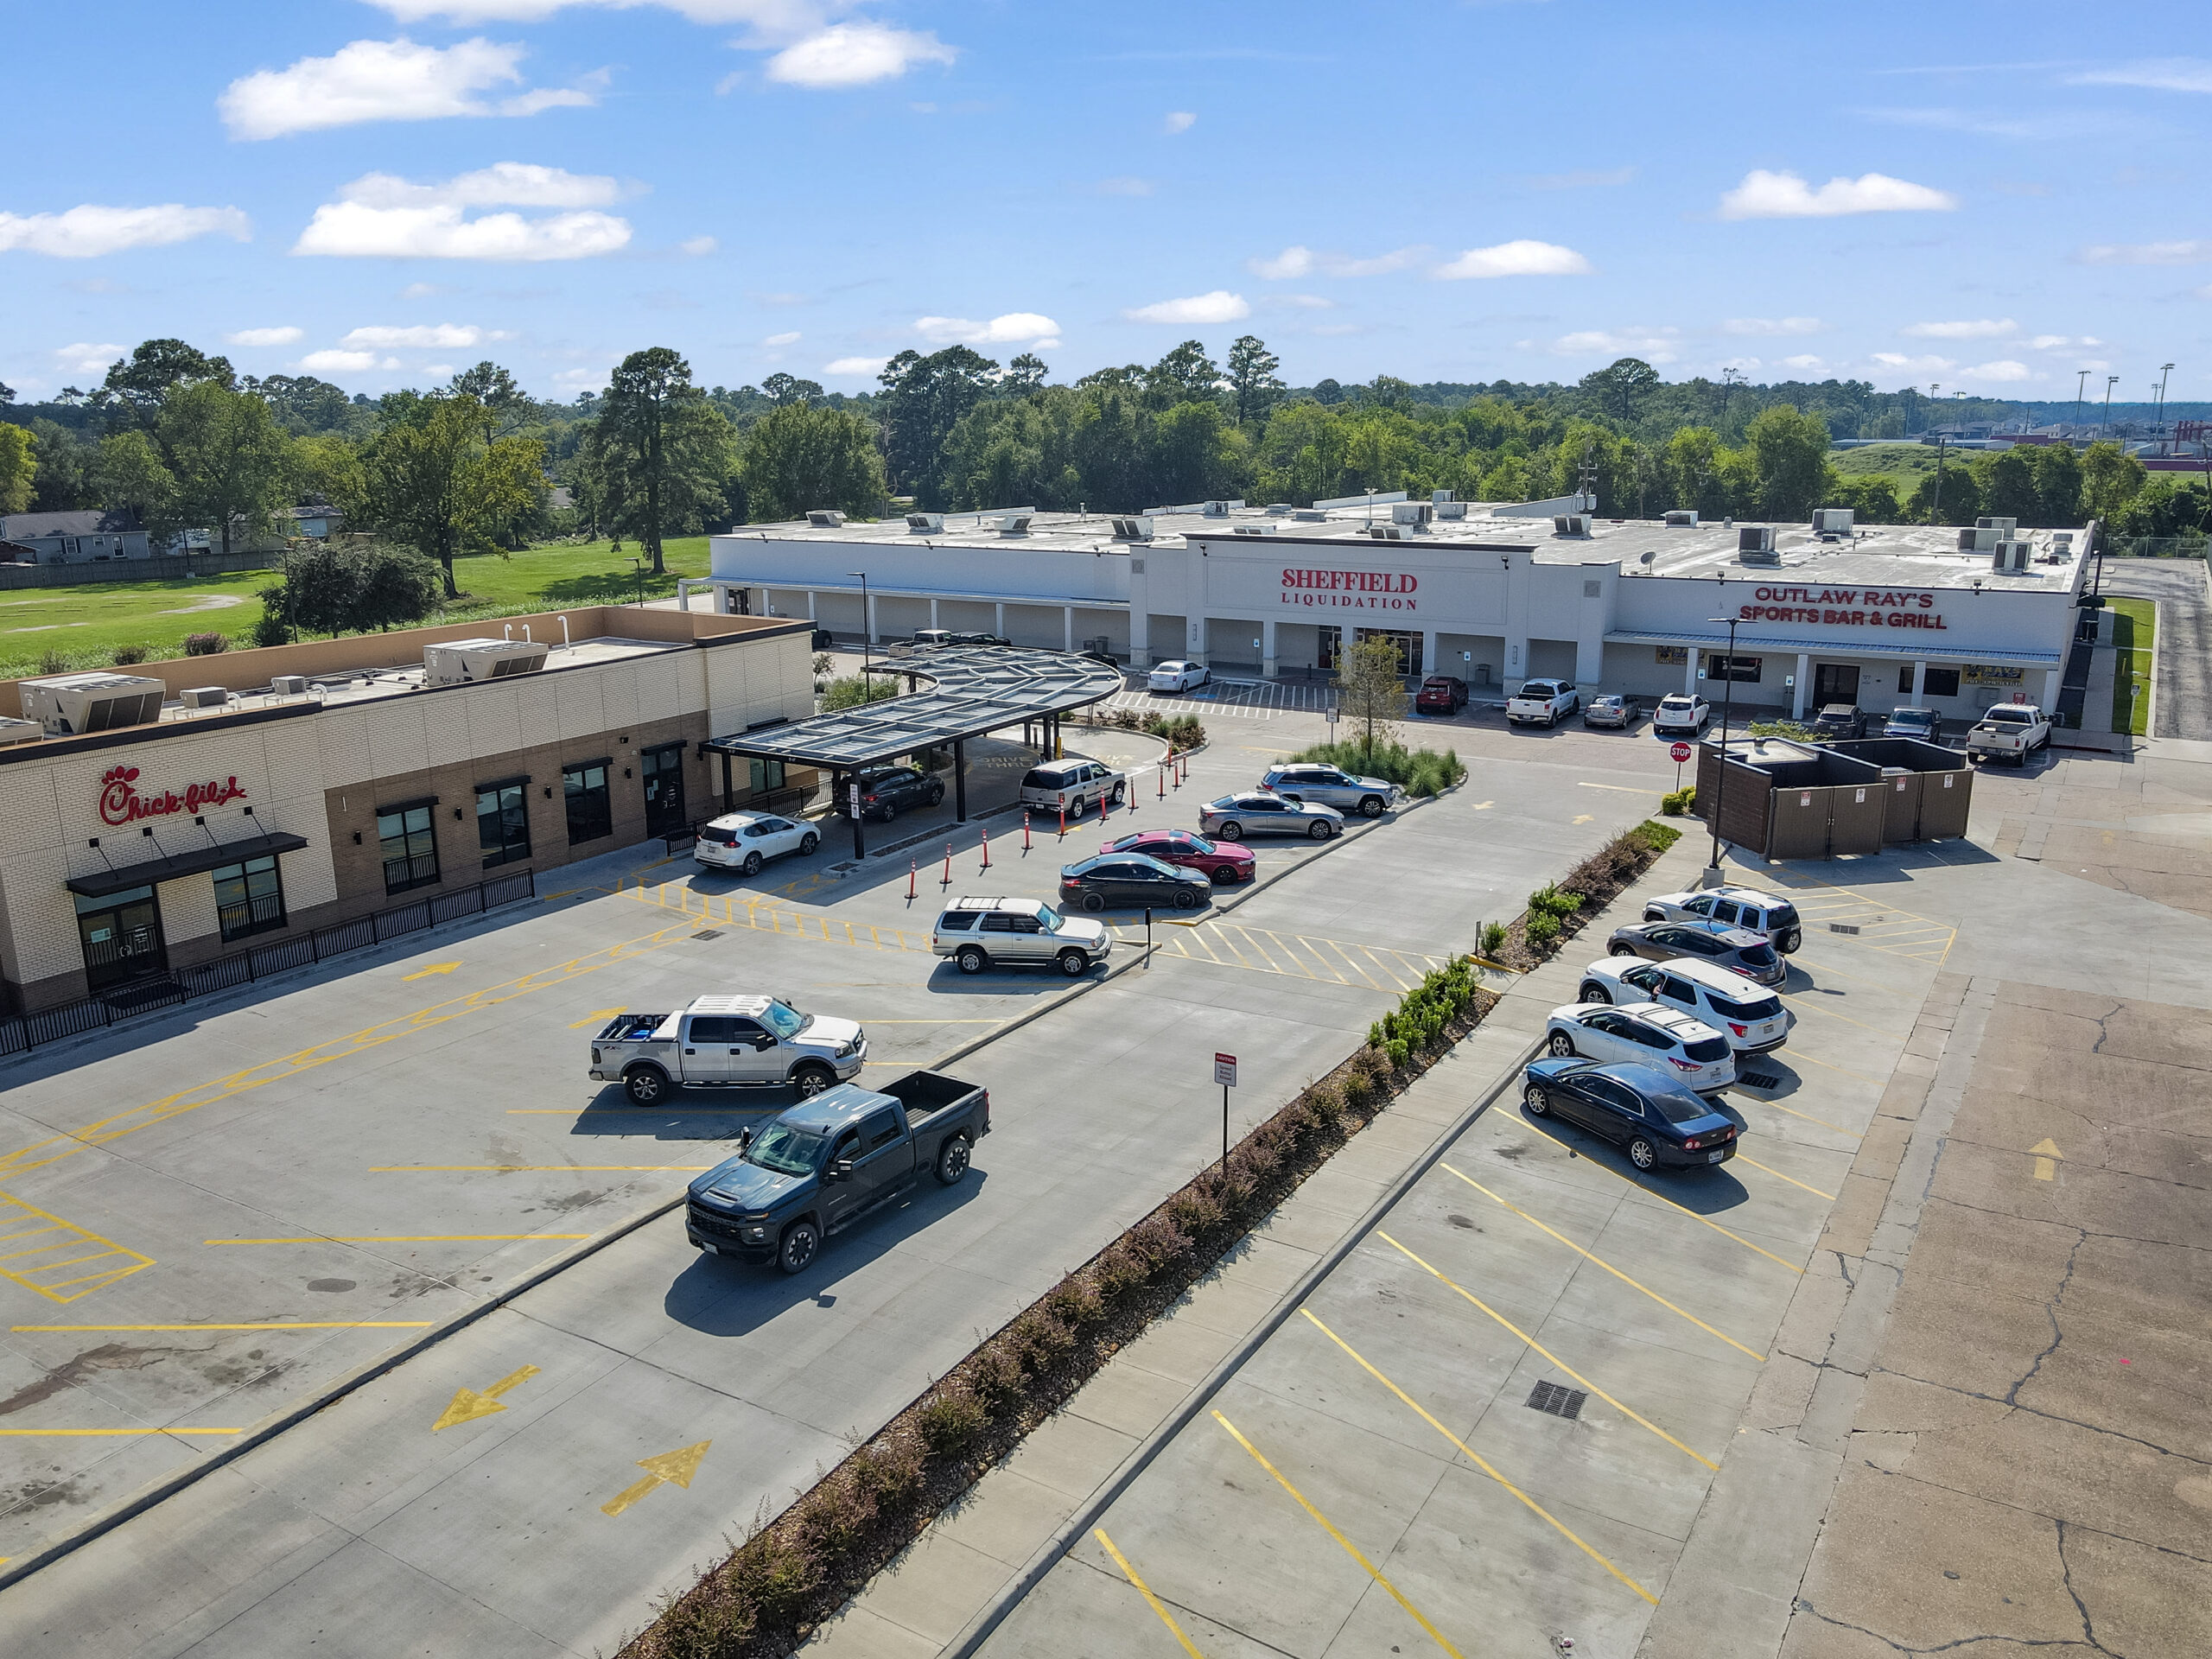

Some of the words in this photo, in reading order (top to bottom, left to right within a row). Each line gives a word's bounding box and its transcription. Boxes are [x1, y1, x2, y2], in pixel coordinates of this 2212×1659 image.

[1281, 569, 1417, 594] SHEFFIELD
[1281, 592, 1417, 610] LIQUIDATION
[1755, 587, 1858, 604] OUTLAW
[1863, 591, 1934, 608] RAY'S
[1739, 606, 1819, 622] SPORTS
[1823, 609, 1865, 626] BAR
[1869, 611, 1884, 626] &
[1887, 612, 1948, 630] GRILL
[1671, 747, 1690, 757] STOP
[99, 772, 247, 826] Chick-fil-A
